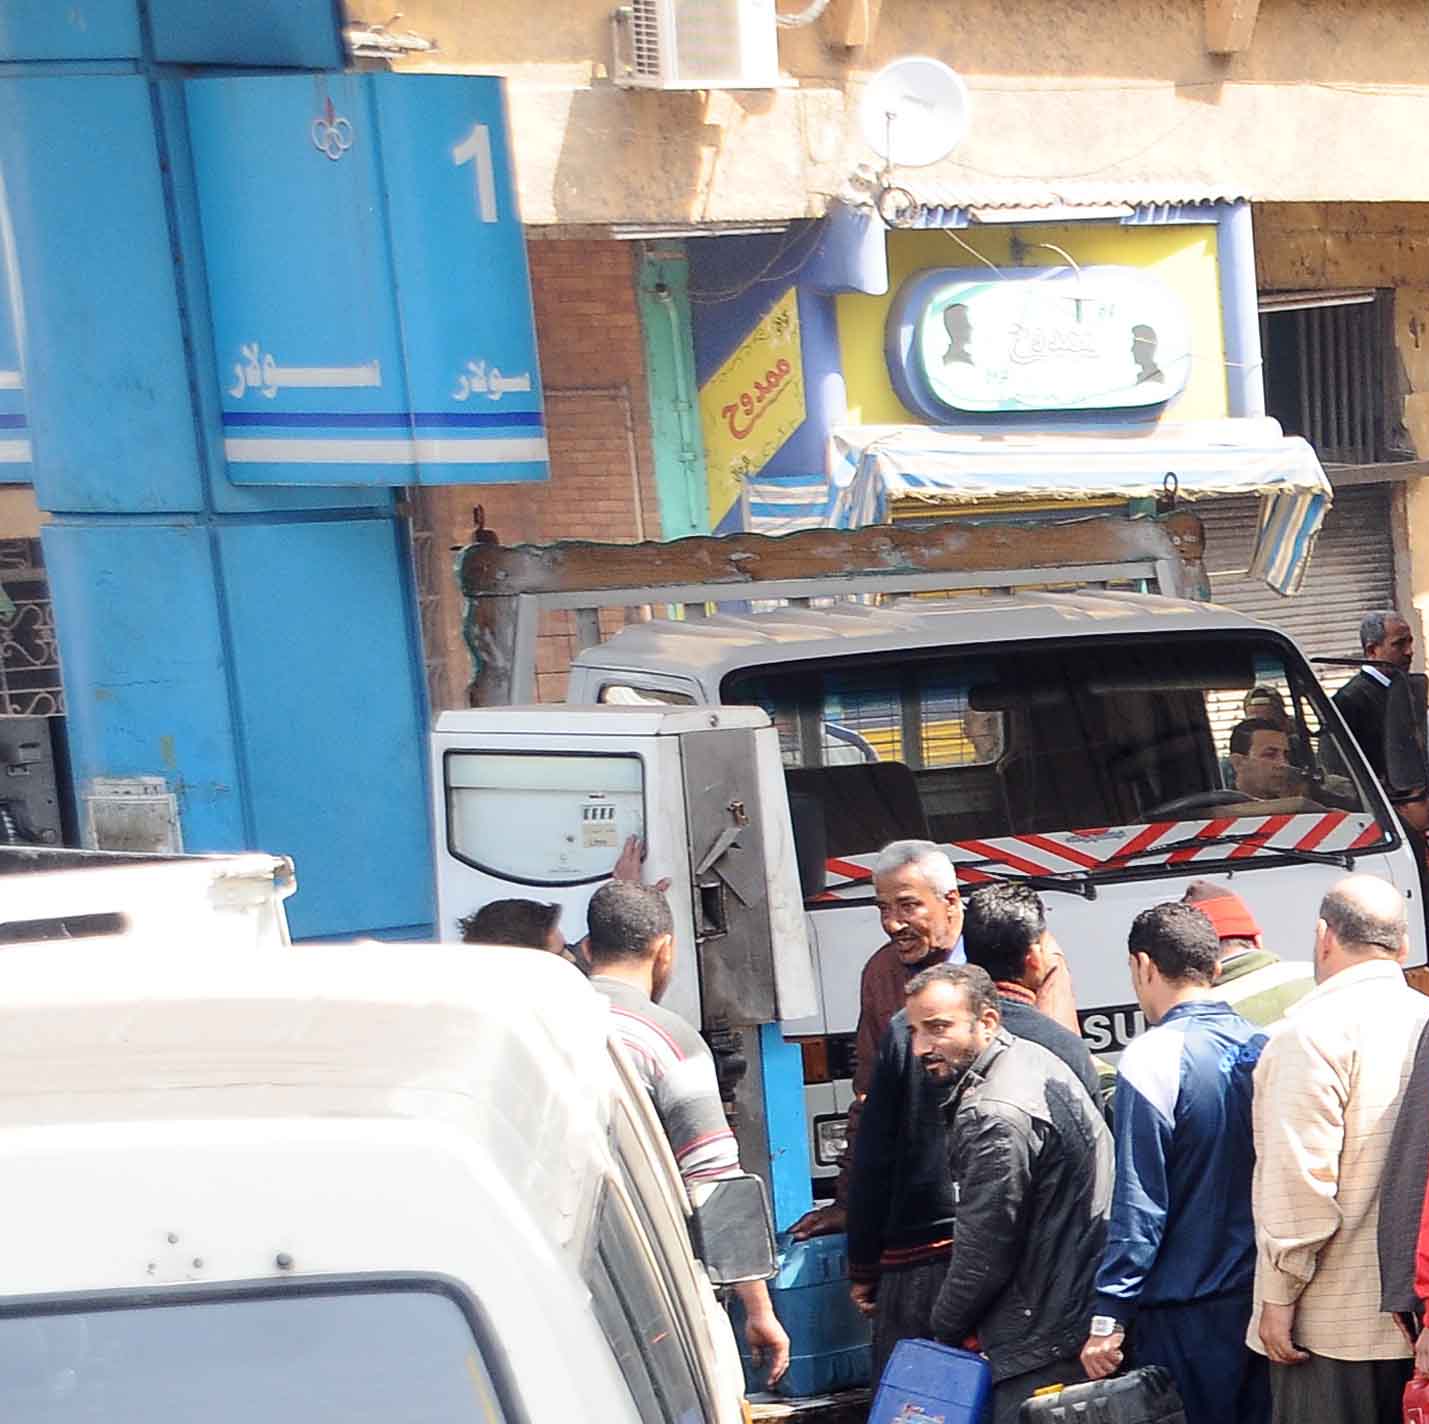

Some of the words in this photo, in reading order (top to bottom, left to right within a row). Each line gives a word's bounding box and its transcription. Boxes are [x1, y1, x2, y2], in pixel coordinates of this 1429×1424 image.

[453, 123, 498, 223] 1
[228, 342, 382, 400] سولار
[451, 359, 532, 401] سولار
[721, 357, 793, 440] ممدوح
